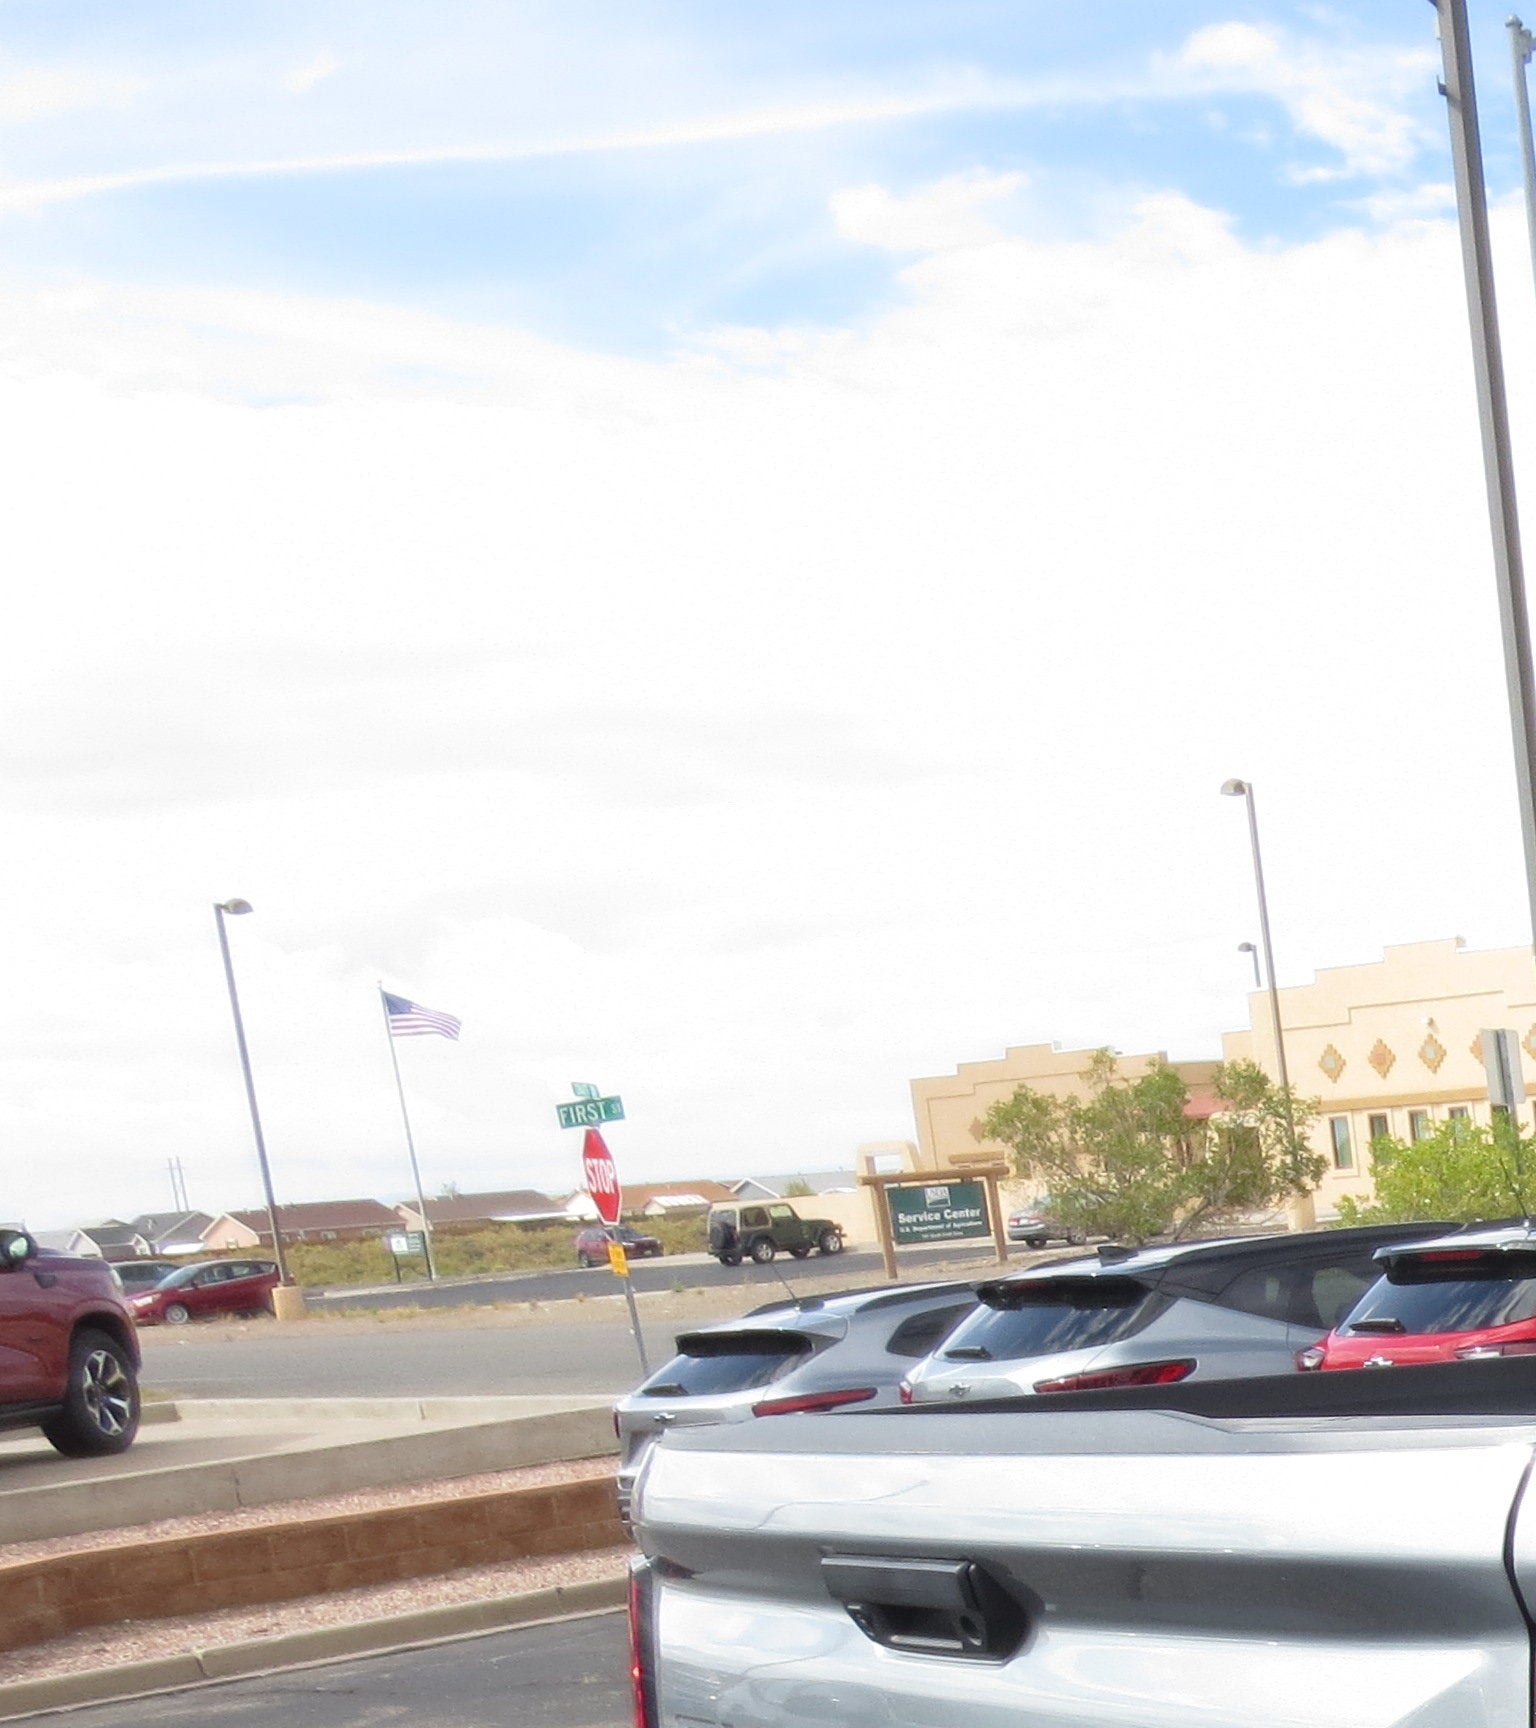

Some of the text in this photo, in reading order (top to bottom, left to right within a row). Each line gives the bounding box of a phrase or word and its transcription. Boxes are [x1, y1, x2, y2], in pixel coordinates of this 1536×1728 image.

[560, 1101, 606, 1127] FIRST
[586, 1158, 616, 1194] STOP
[898, 1208, 981, 1224] Service Center
